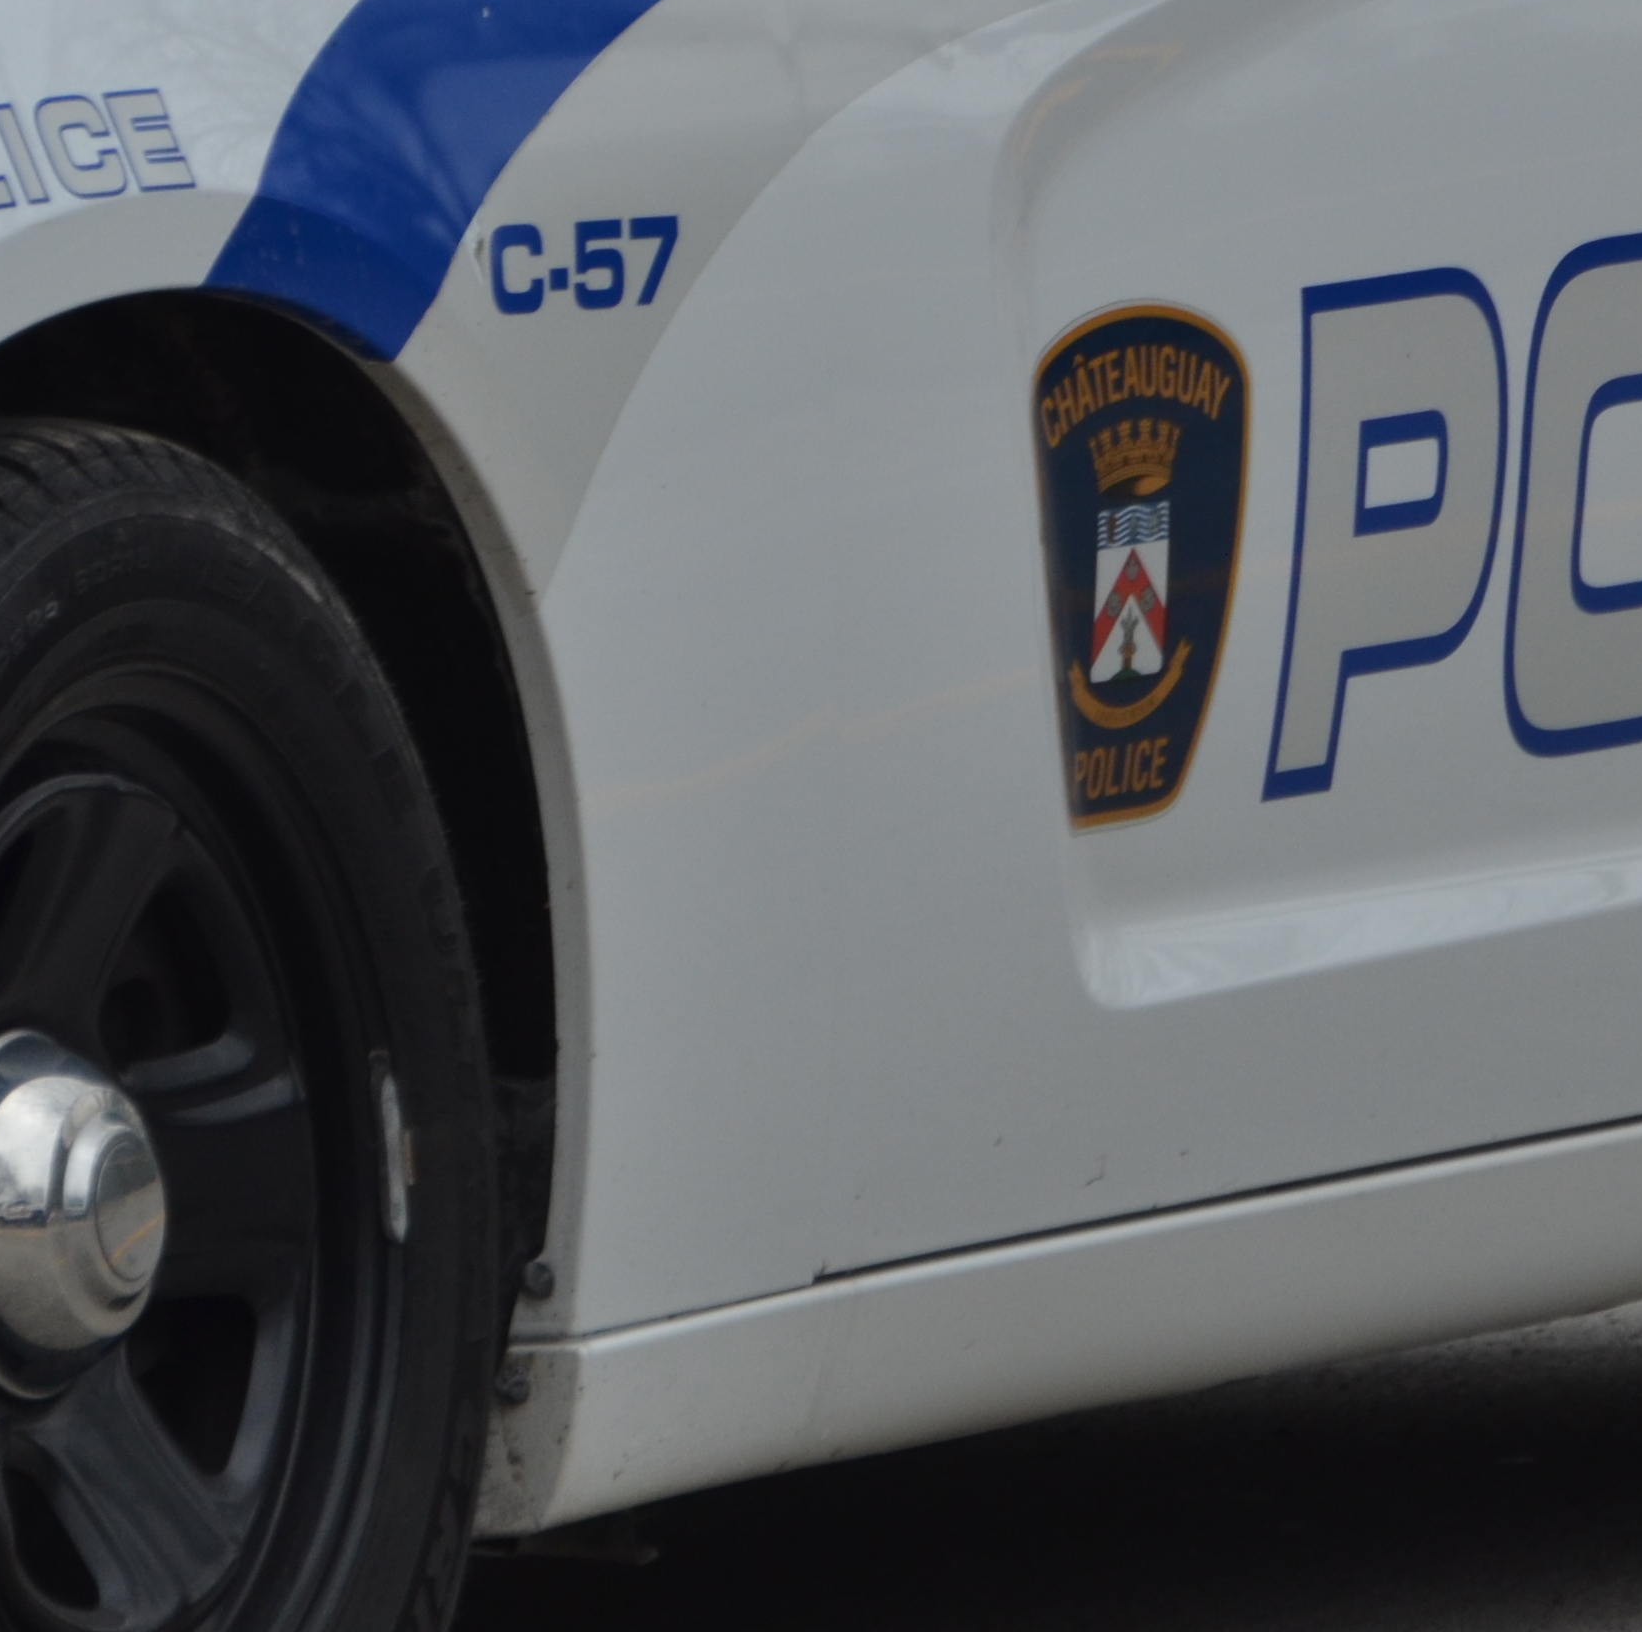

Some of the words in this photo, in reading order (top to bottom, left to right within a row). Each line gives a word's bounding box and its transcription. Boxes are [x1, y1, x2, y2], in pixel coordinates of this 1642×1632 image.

[490, 215, 678, 314] C-57
[1040, 344, 1232, 449] CHÂTEAUGUAY
[1073, 736, 1170, 801] POLICE
